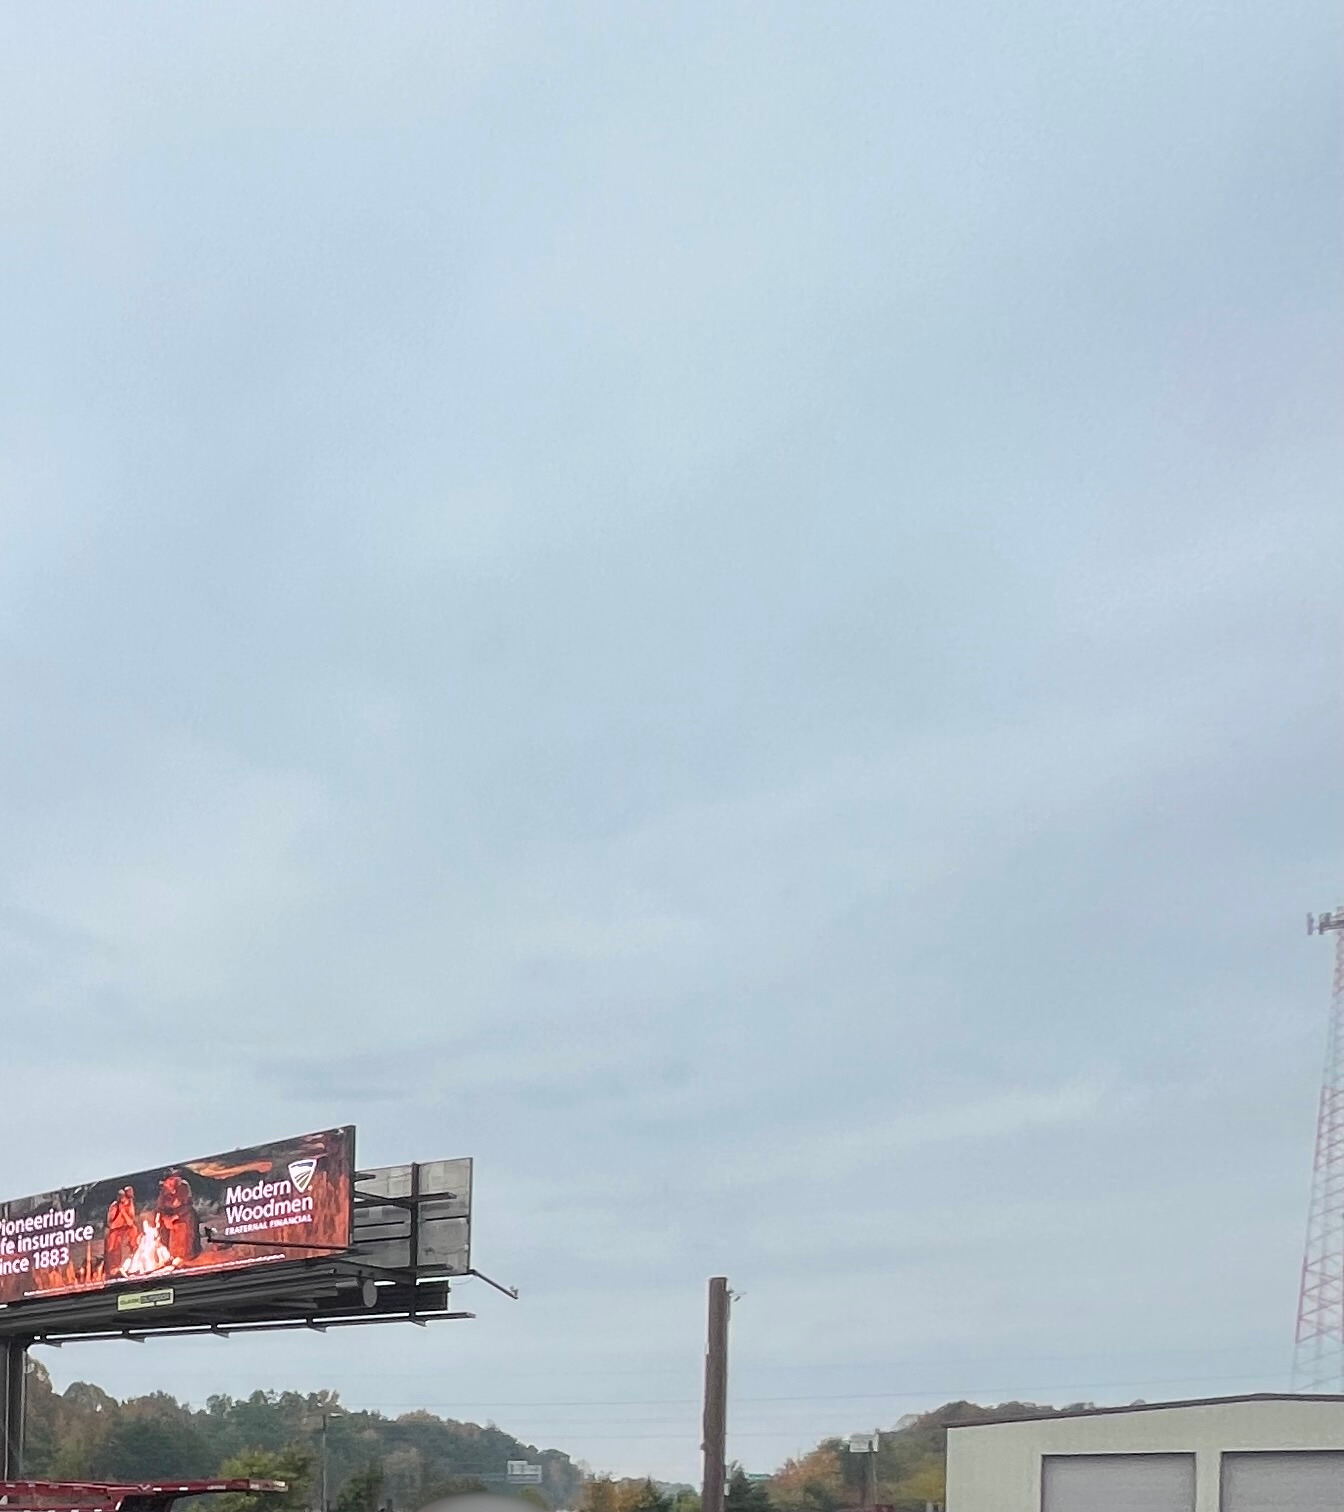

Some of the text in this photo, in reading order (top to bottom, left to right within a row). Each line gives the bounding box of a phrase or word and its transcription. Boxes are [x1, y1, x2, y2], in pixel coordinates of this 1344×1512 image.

[226, 1180, 291, 1205] Modern
[226, 1196, 313, 1224] Woodmen
[225, 1214, 313, 1235] FRATERNAL FINANCIAL
[17, 1225, 94, 1252] insurance
[33, 1247, 70, 1270] 1883
